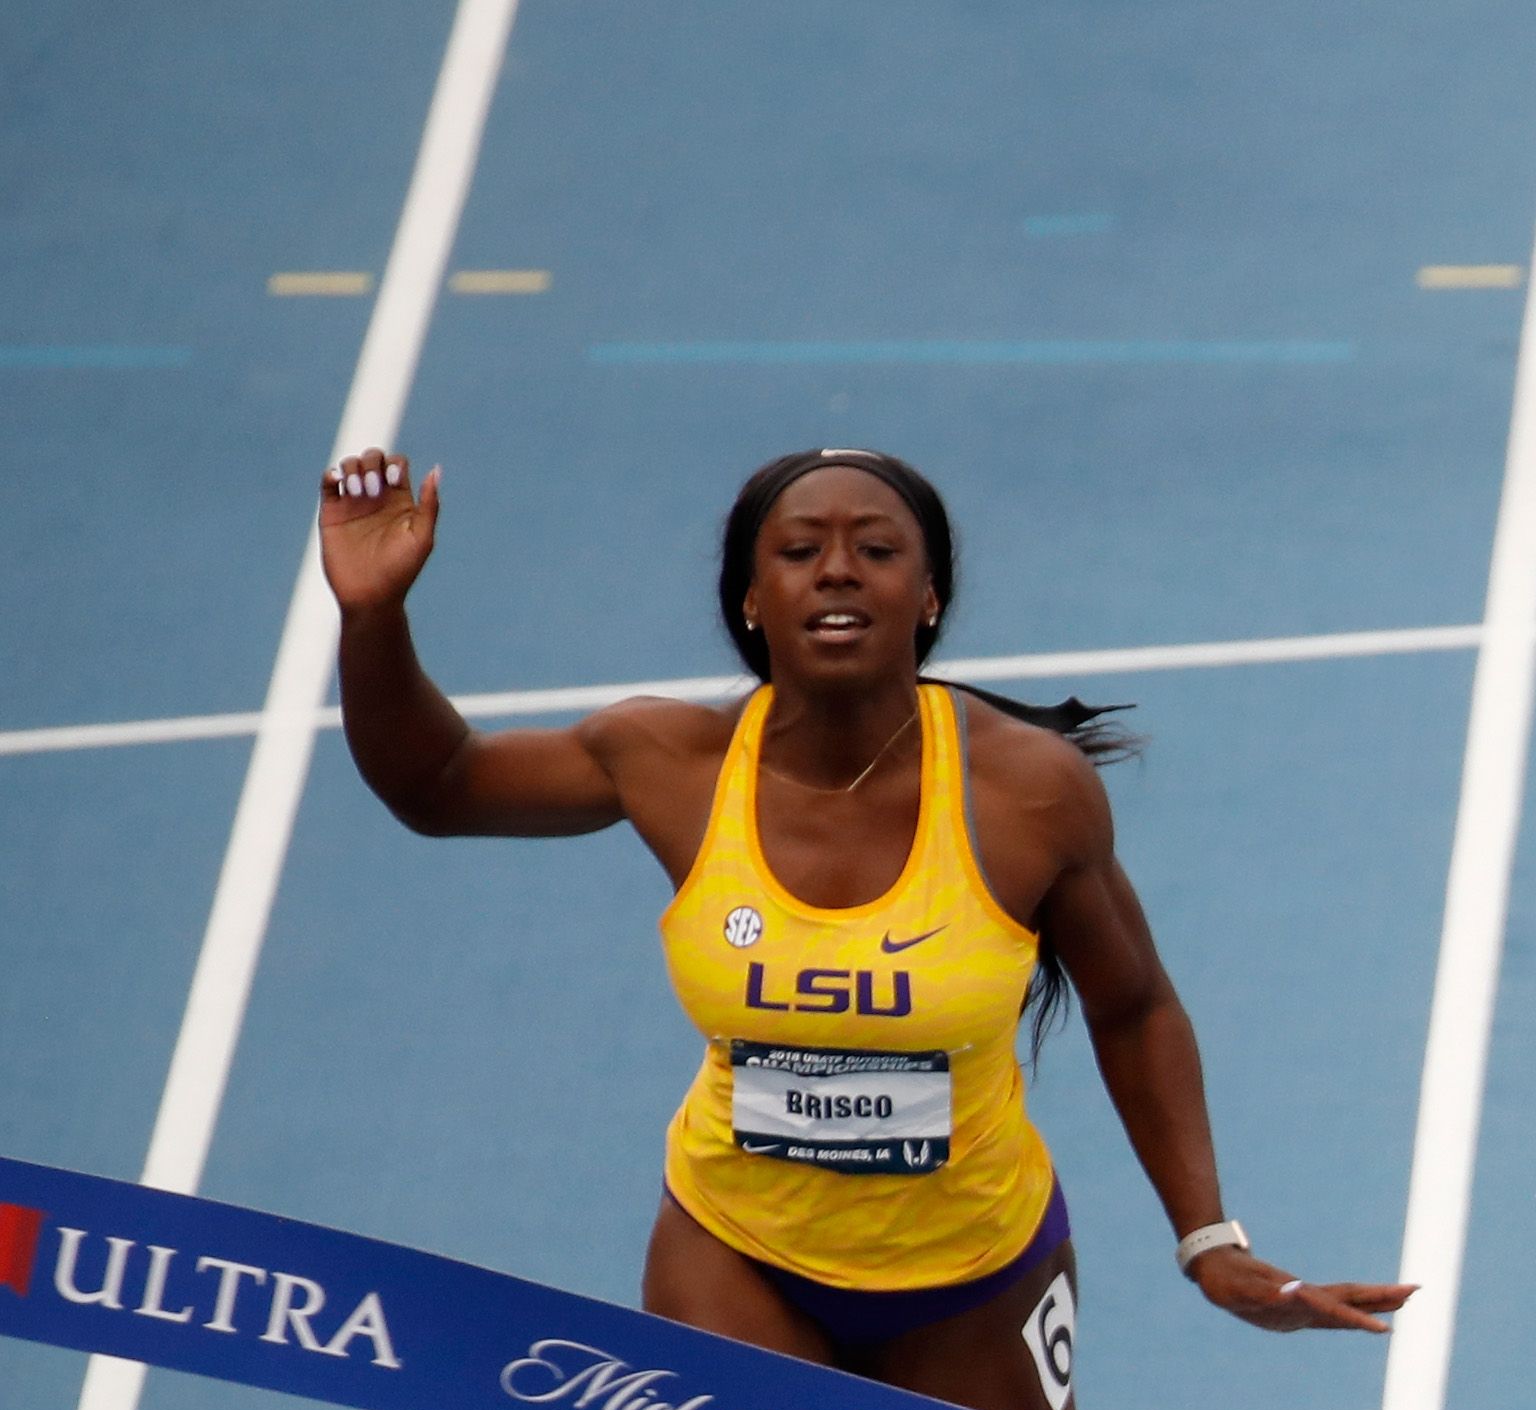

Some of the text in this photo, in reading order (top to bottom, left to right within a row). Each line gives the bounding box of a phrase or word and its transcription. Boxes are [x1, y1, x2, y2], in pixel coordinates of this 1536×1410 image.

[724, 906, 762, 947] SEC
[745, 962, 912, 1017] LSU
[786, 1089, 893, 1119] BRISCO
[787, 1146, 891, 1162] DES MOINES, IA
[53, 1226, 403, 1369] ULTRA
[1038, 1293, 1072, 1387] 6
